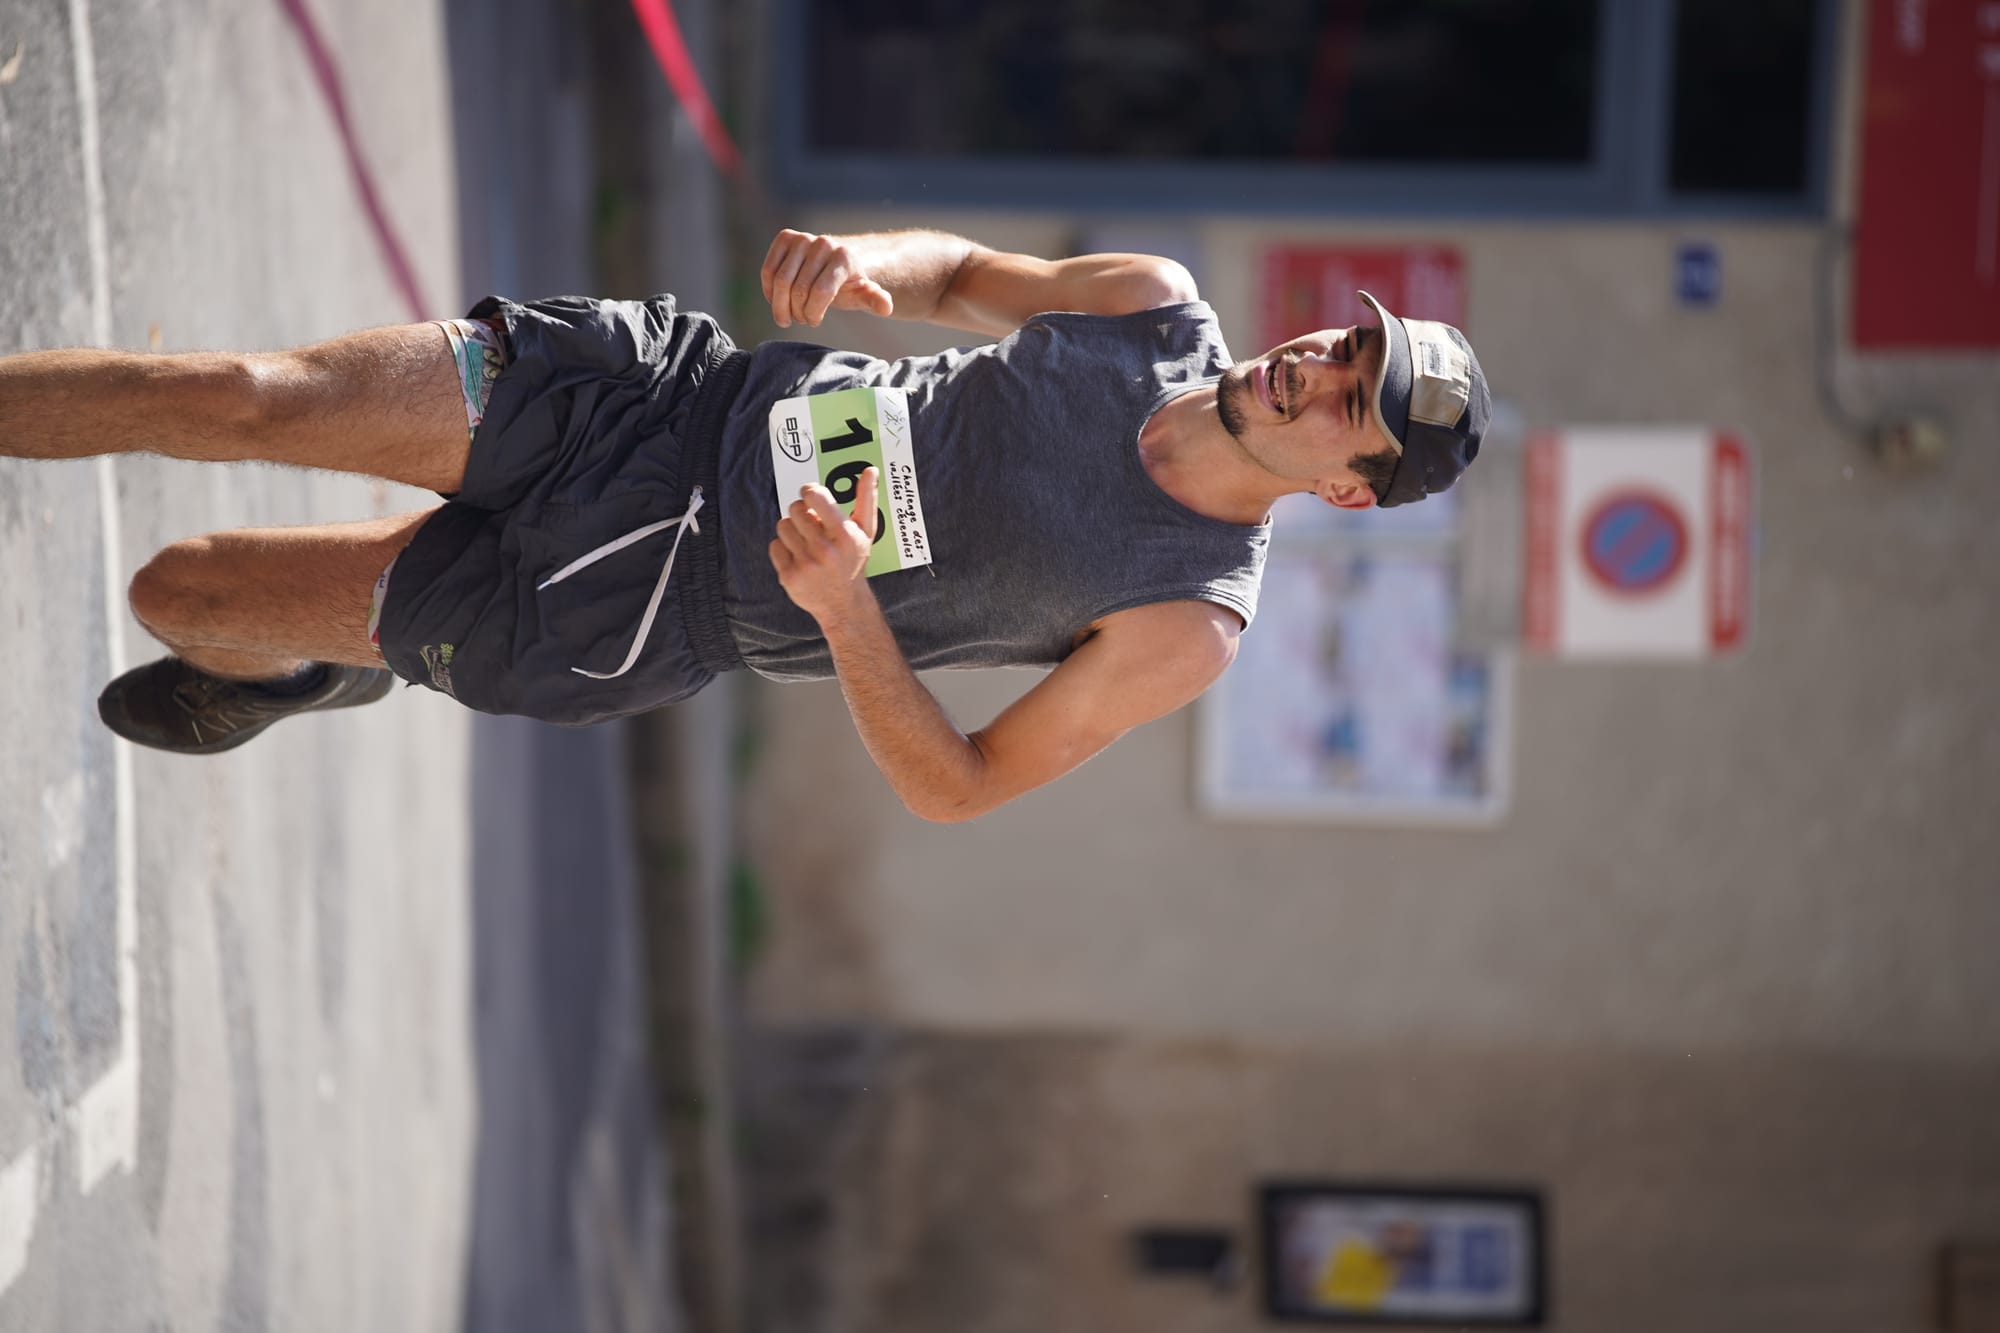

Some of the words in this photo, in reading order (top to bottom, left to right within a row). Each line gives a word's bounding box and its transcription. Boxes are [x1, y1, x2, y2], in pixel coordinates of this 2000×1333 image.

[786, 417, 802, 457] BFP
[889, 461, 903, 500] vallées
[896, 508, 913, 558] cévenoles
[902, 465, 917, 523] Challenge
[913, 530, 924, 550] des
